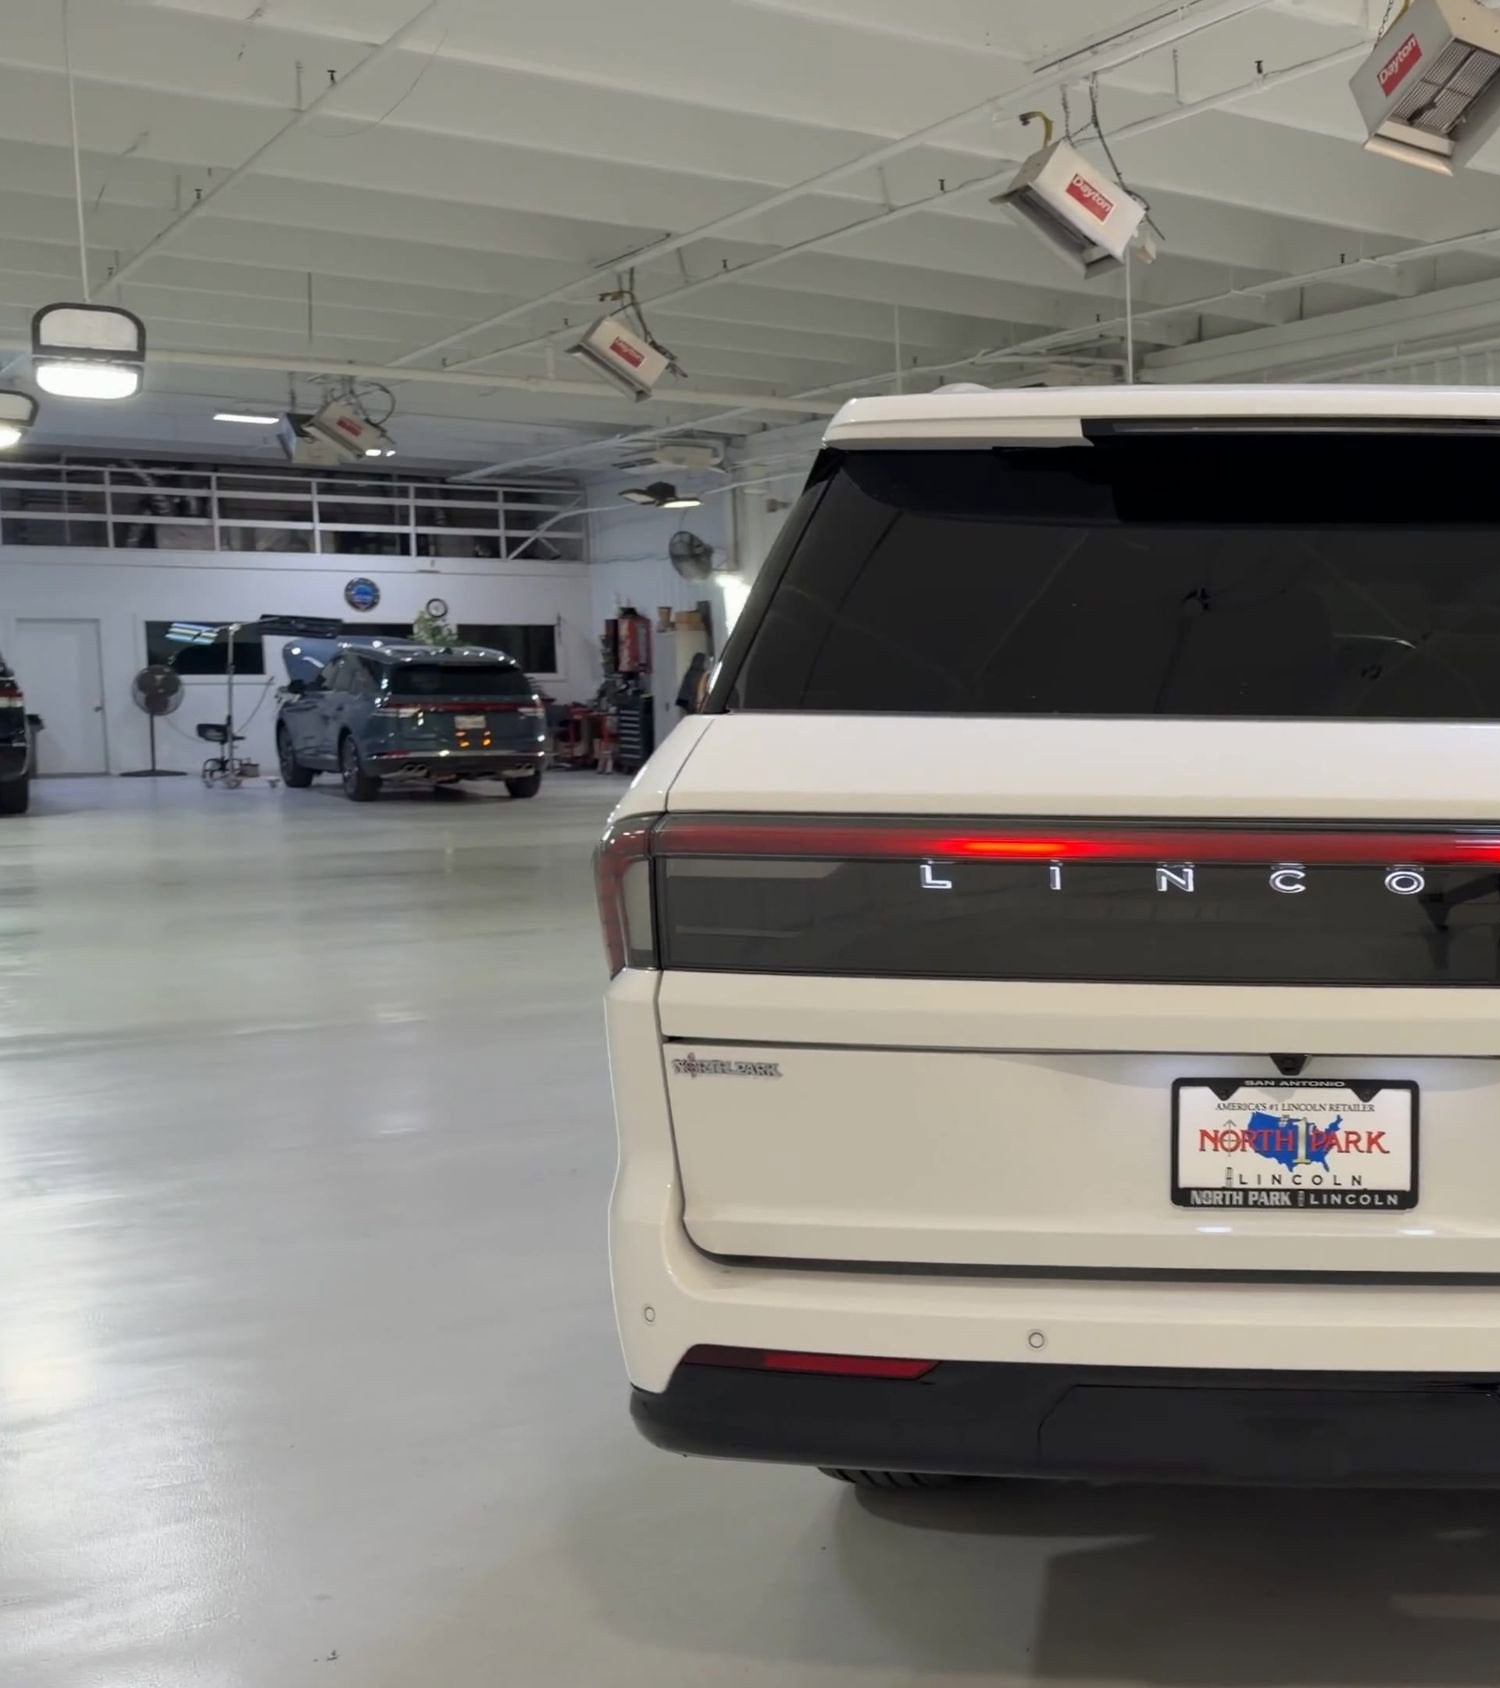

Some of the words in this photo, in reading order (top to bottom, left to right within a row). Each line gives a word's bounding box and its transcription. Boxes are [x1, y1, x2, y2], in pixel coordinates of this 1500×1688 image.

[1378, 36, 1417, 84] Dayton
[1072, 175, 1112, 212] Dayton
[1215, 1102, 1267, 1111] AMERICA'S
[1269, 1103, 1279, 1111] #1
[1281, 1103, 1327, 1112] LINCOLN
[1328, 1103, 1376, 1112] RETAILER
[1199, 1129, 1295, 1152] NORTH
[1311, 1128, 1391, 1154] PARK
[1239, 1174, 1363, 1186] LINCOLN
[1190, 1191, 1244, 1206] NORTH
[1249, 1191, 1293, 1206] PARK
[1310, 1194, 1399, 1206] LINCOLN
